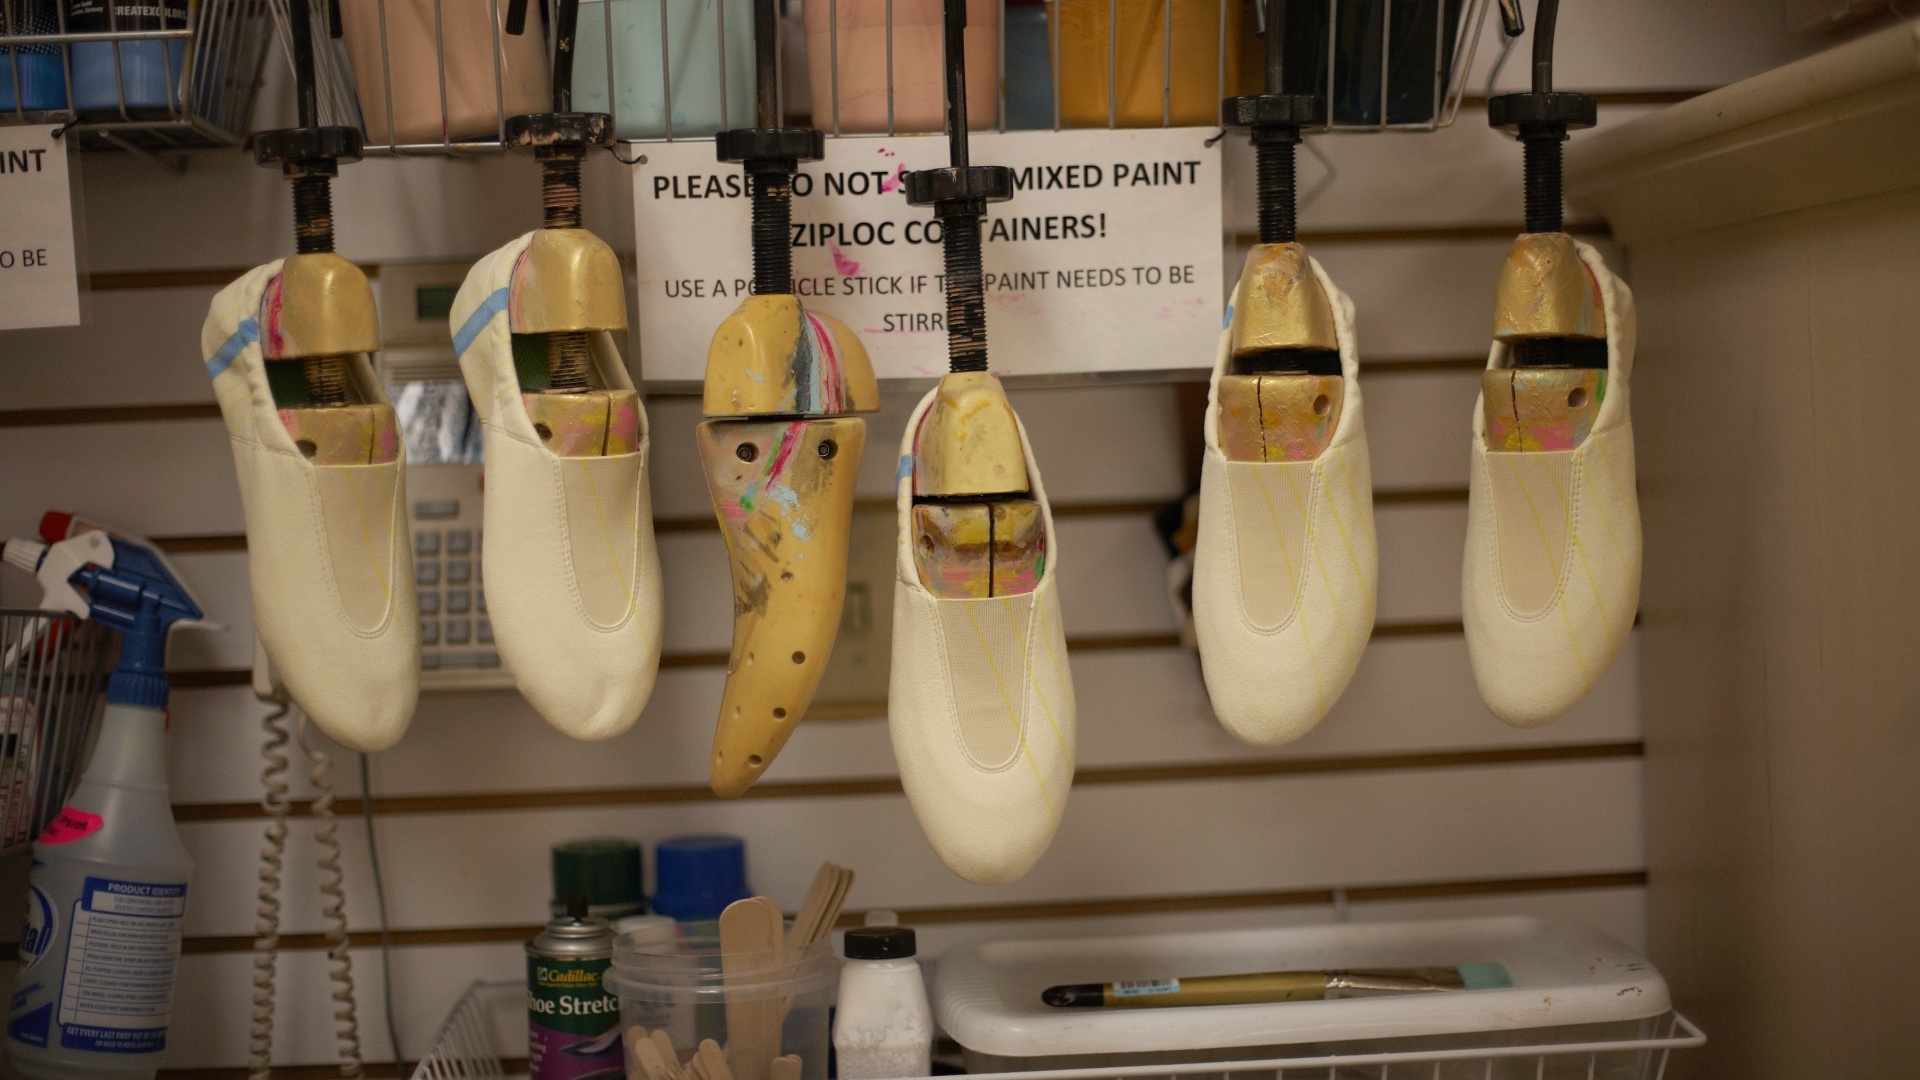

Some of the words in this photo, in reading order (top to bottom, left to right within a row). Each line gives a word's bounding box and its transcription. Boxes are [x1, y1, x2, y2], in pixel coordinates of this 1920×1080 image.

[824, 171, 889, 196] NOT
[1010, 164, 1103, 191] MIXED
[1113, 161, 1201, 187] PAINT
[791, 221, 895, 247] ZIPLOC
[904, 213, 1106, 245] COAINERS!
[22, 249, 48, 267] BE
[665, 279, 705, 298] USE
[712, 279, 728, 297] A
[842, 276, 902, 295] STICK
[910, 275, 928, 293] IF
[985, 271, 1049, 291] PAINT
[1056, 268, 1126, 288] NEEDS
[1132, 266, 1162, 285] TO
[1169, 265, 1195, 284] BE
[883, 312, 944, 332] STIRR
[108, 882, 150, 896] PRODUCT
[548, 969, 598, 982] Cadillac
[529, 991, 555, 1014] hoe
[560, 995, 620, 1016] Stretc
[66, 1026, 79, 1036] GET
[79, 1028, 99, 1038] EVERY
[100, 1030, 115, 1039] LAST
